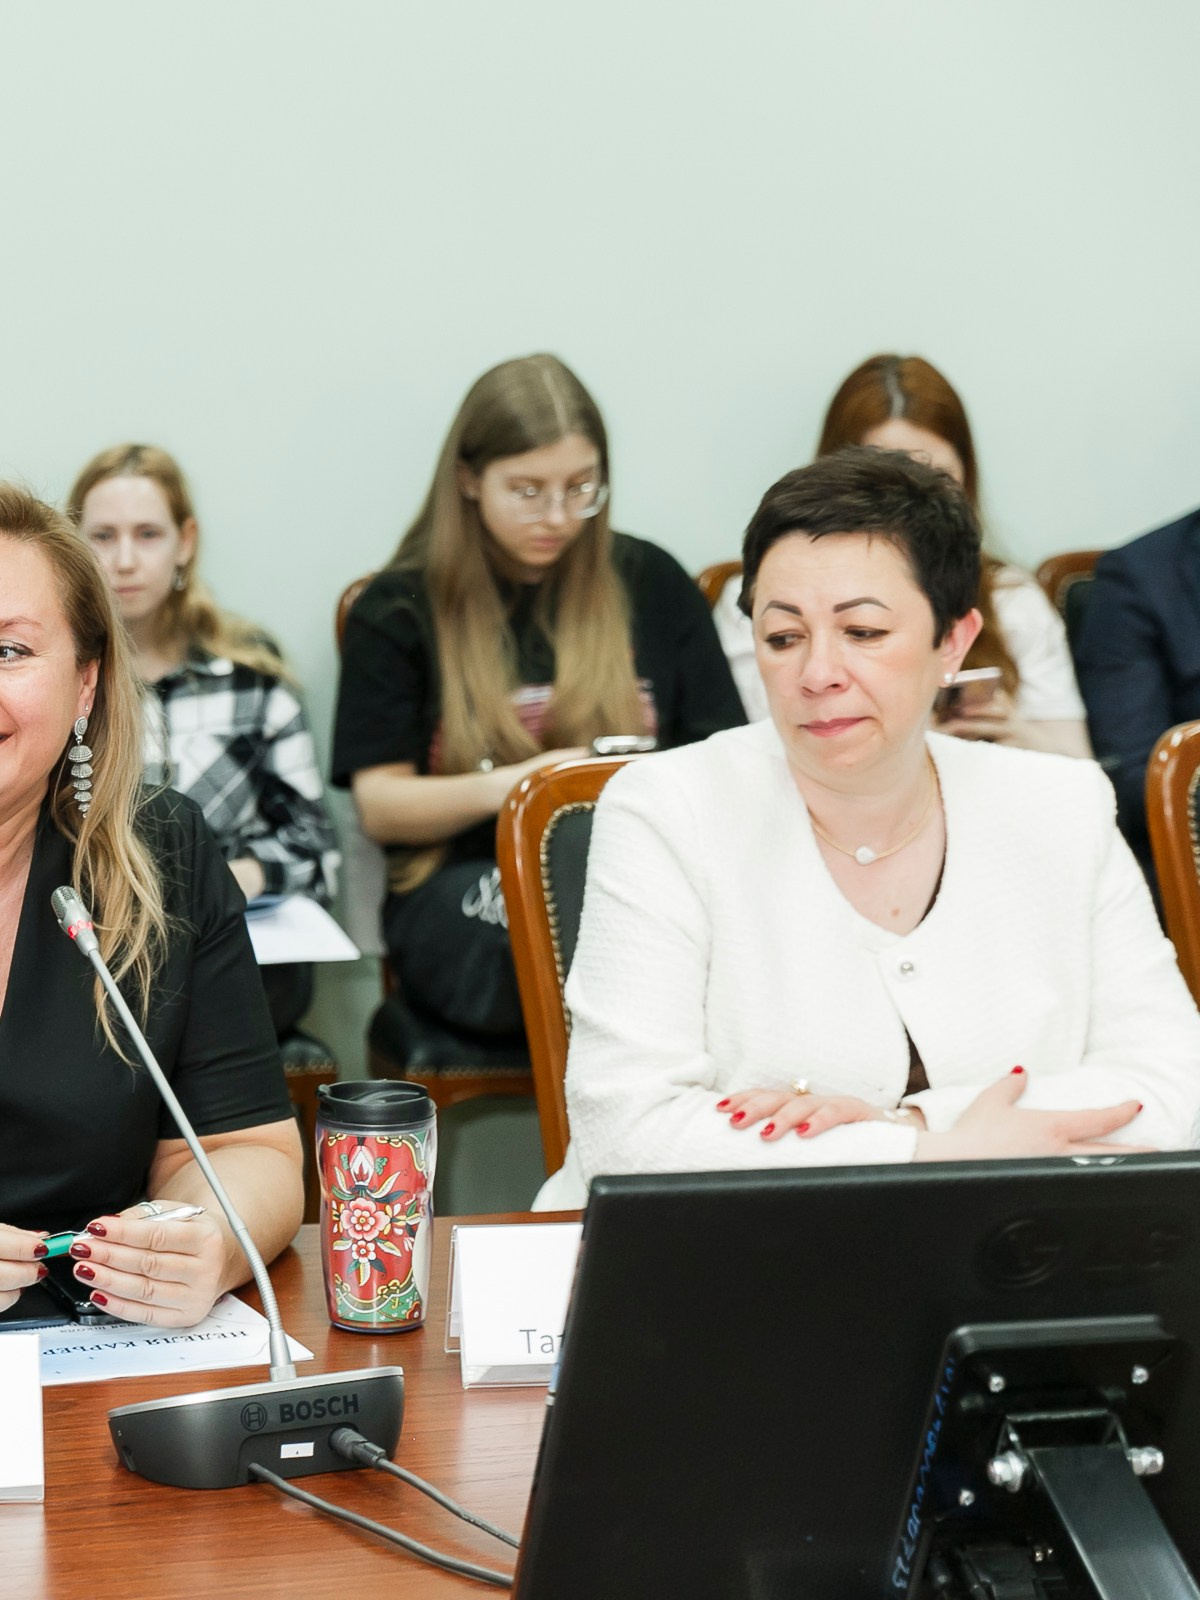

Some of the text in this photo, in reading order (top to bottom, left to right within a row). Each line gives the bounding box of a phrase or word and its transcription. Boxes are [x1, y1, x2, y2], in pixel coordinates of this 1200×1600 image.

[42, 1330, 248, 1356] НЕДЕЛЯ КАРЬЕР
[279, 1394, 359, 1424] BOSCH
